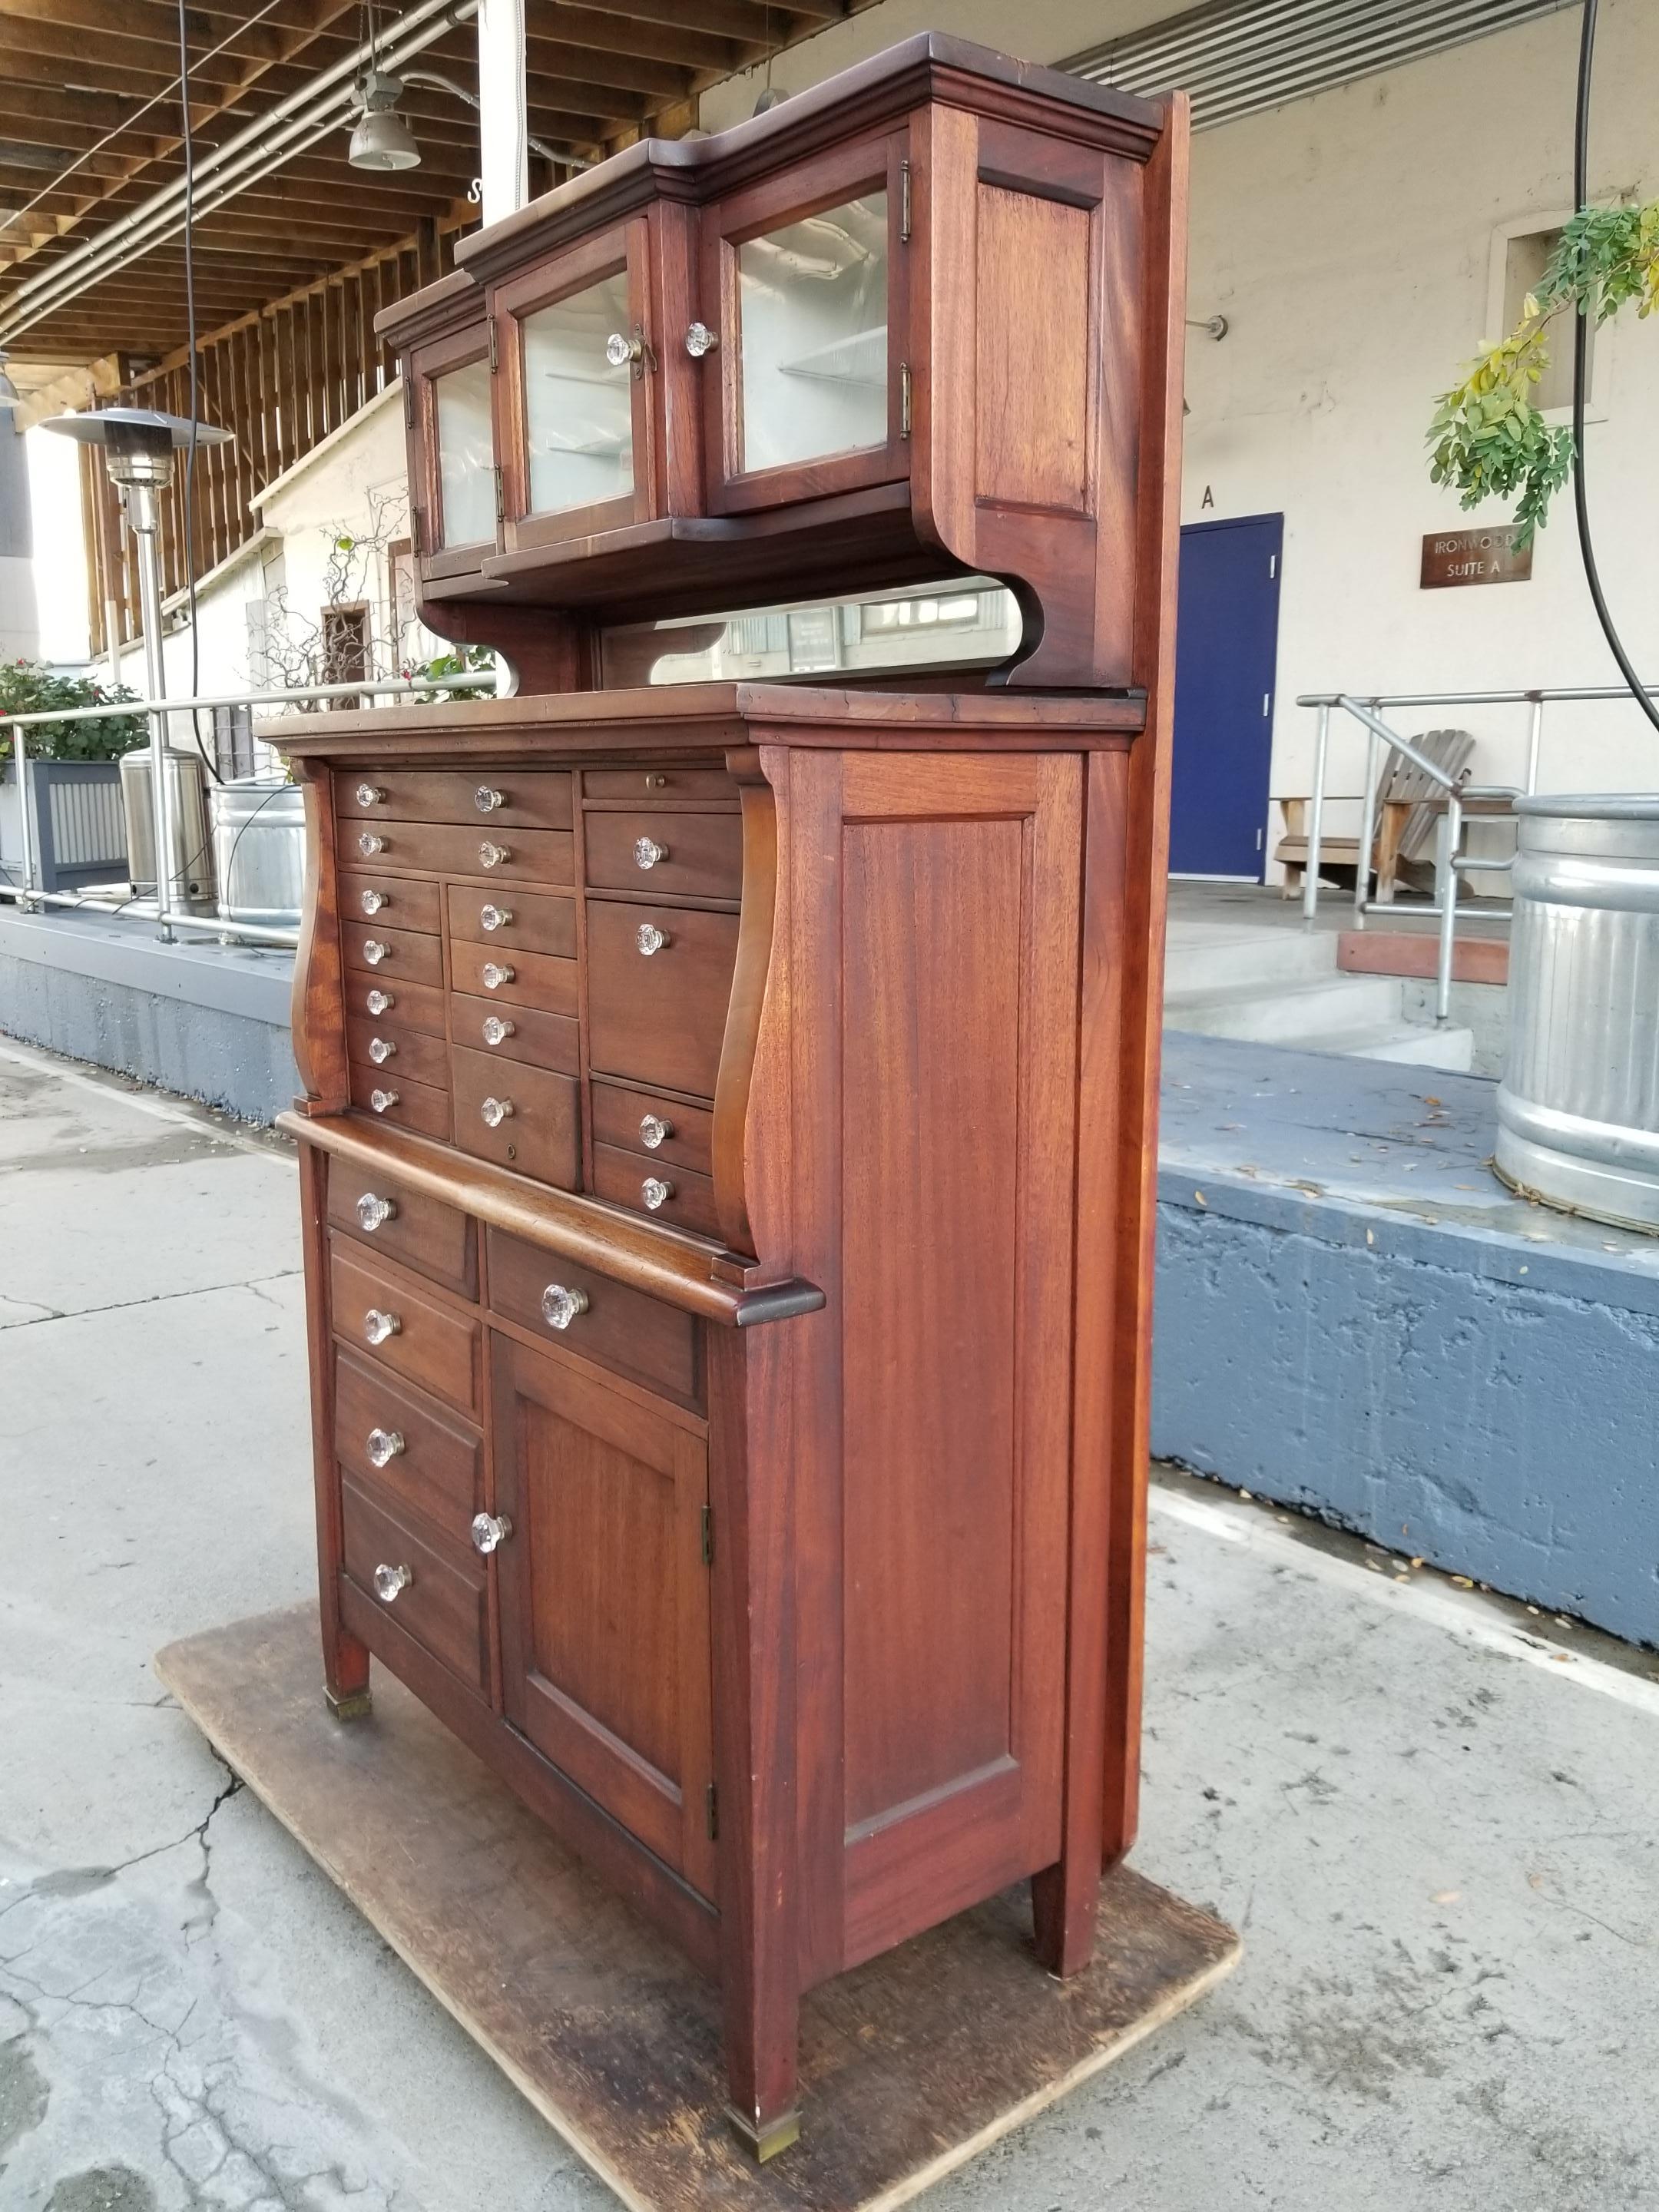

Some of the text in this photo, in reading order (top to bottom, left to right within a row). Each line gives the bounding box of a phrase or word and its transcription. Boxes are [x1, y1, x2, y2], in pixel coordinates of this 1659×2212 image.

[1201, 485, 1214, 509] A
[1447, 560, 1500, 577] SUITE A
